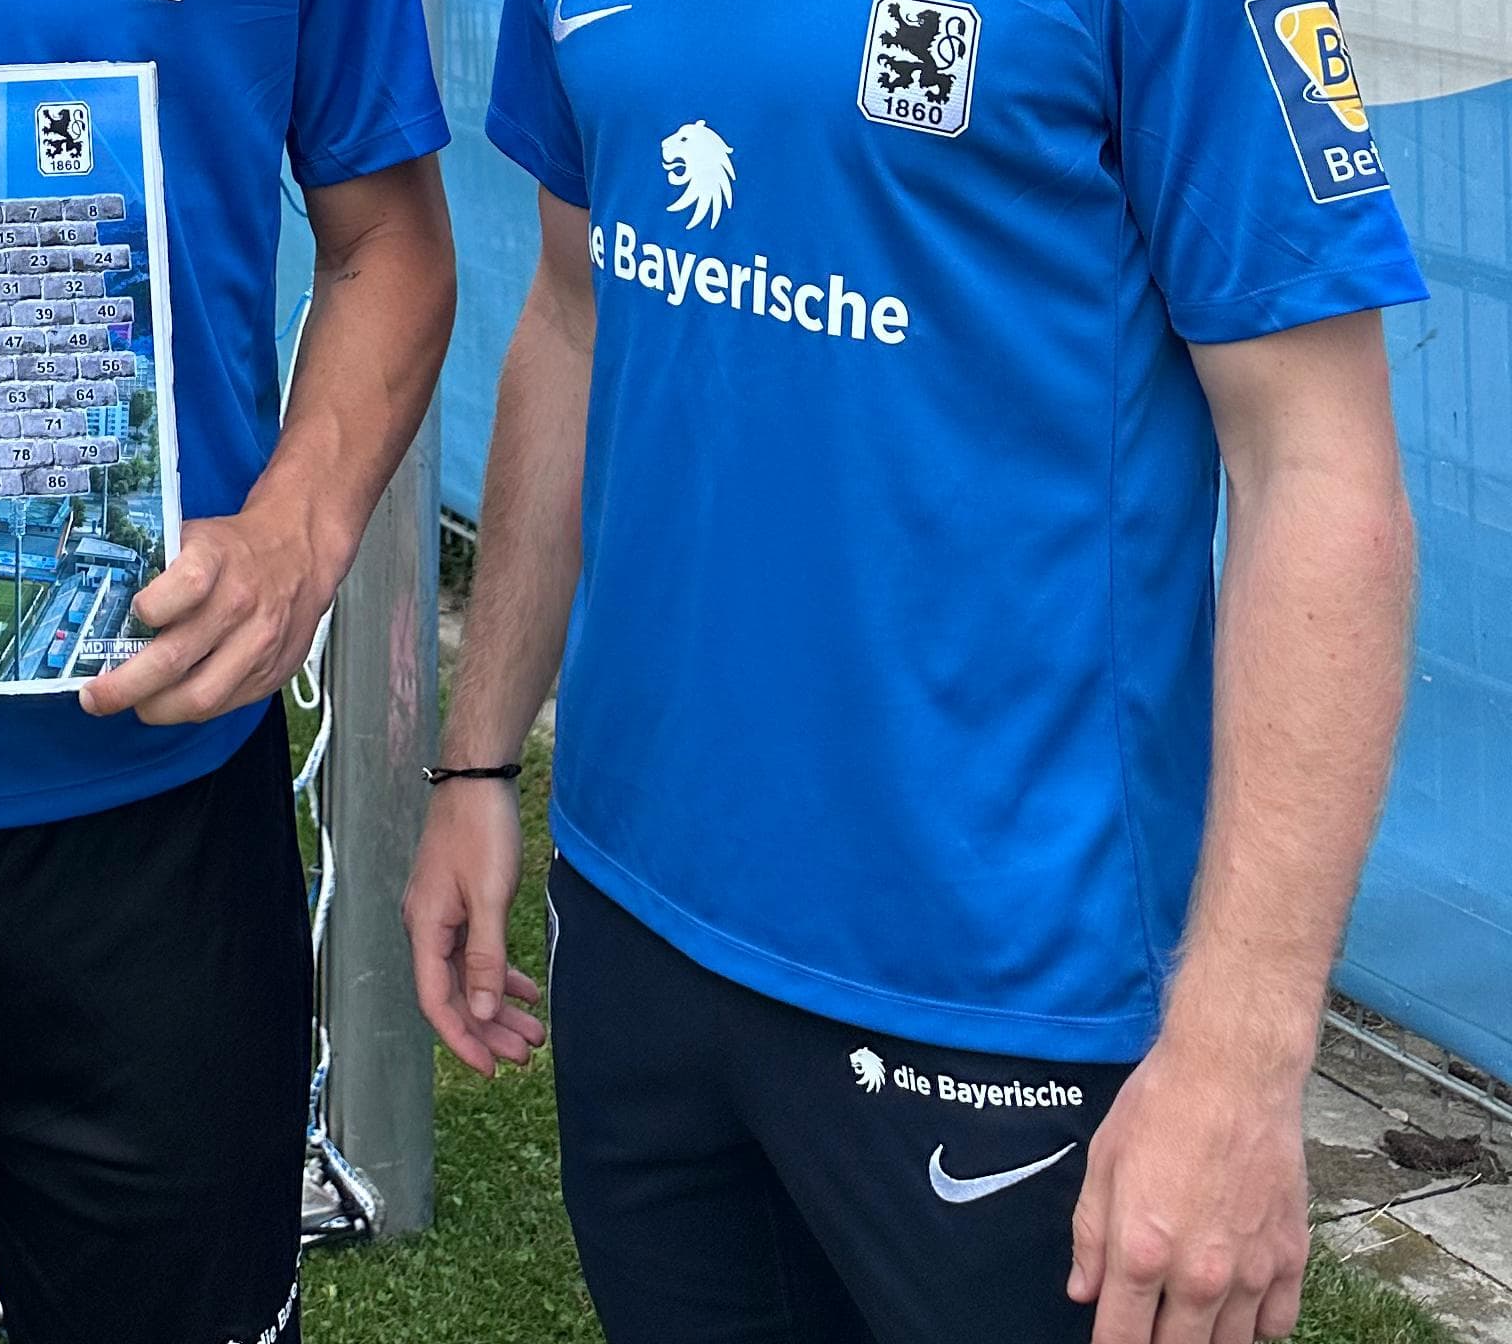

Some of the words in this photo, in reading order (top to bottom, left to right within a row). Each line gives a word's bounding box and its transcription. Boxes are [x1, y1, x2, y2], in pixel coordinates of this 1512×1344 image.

[883, 95, 944, 126] 1860
[49, 159, 82, 172] 1860
[29, 207, 38, 219] 7
[89, 205, 98, 217] 8
[61, 229, 77, 241] 16
[30, 255, 48, 267] 23
[94, 252, 113, 264] 24
[3, 282, 19, 294] 31
[65, 280, 83, 292] 32
[613, 221, 909, 346] Bayerische
[36, 308, 53, 320] 39
[97, 305, 116, 317] 40
[5, 336, 23, 348] 47
[69, 333, 88, 346] 48
[37, 361, 55, 374] 55
[102, 359, 120, 372] 56
[8, 391, 27, 403] 63
[76, 388, 94, 401] 64
[45, 418, 62, 431] 71
[12, 449, 31, 461] 78
[79, 445, 98, 457] 79
[48, 476, 67, 488] 86
[893, 1065, 931, 1096] die
[937, 1074, 1084, 1109] Bayerische
